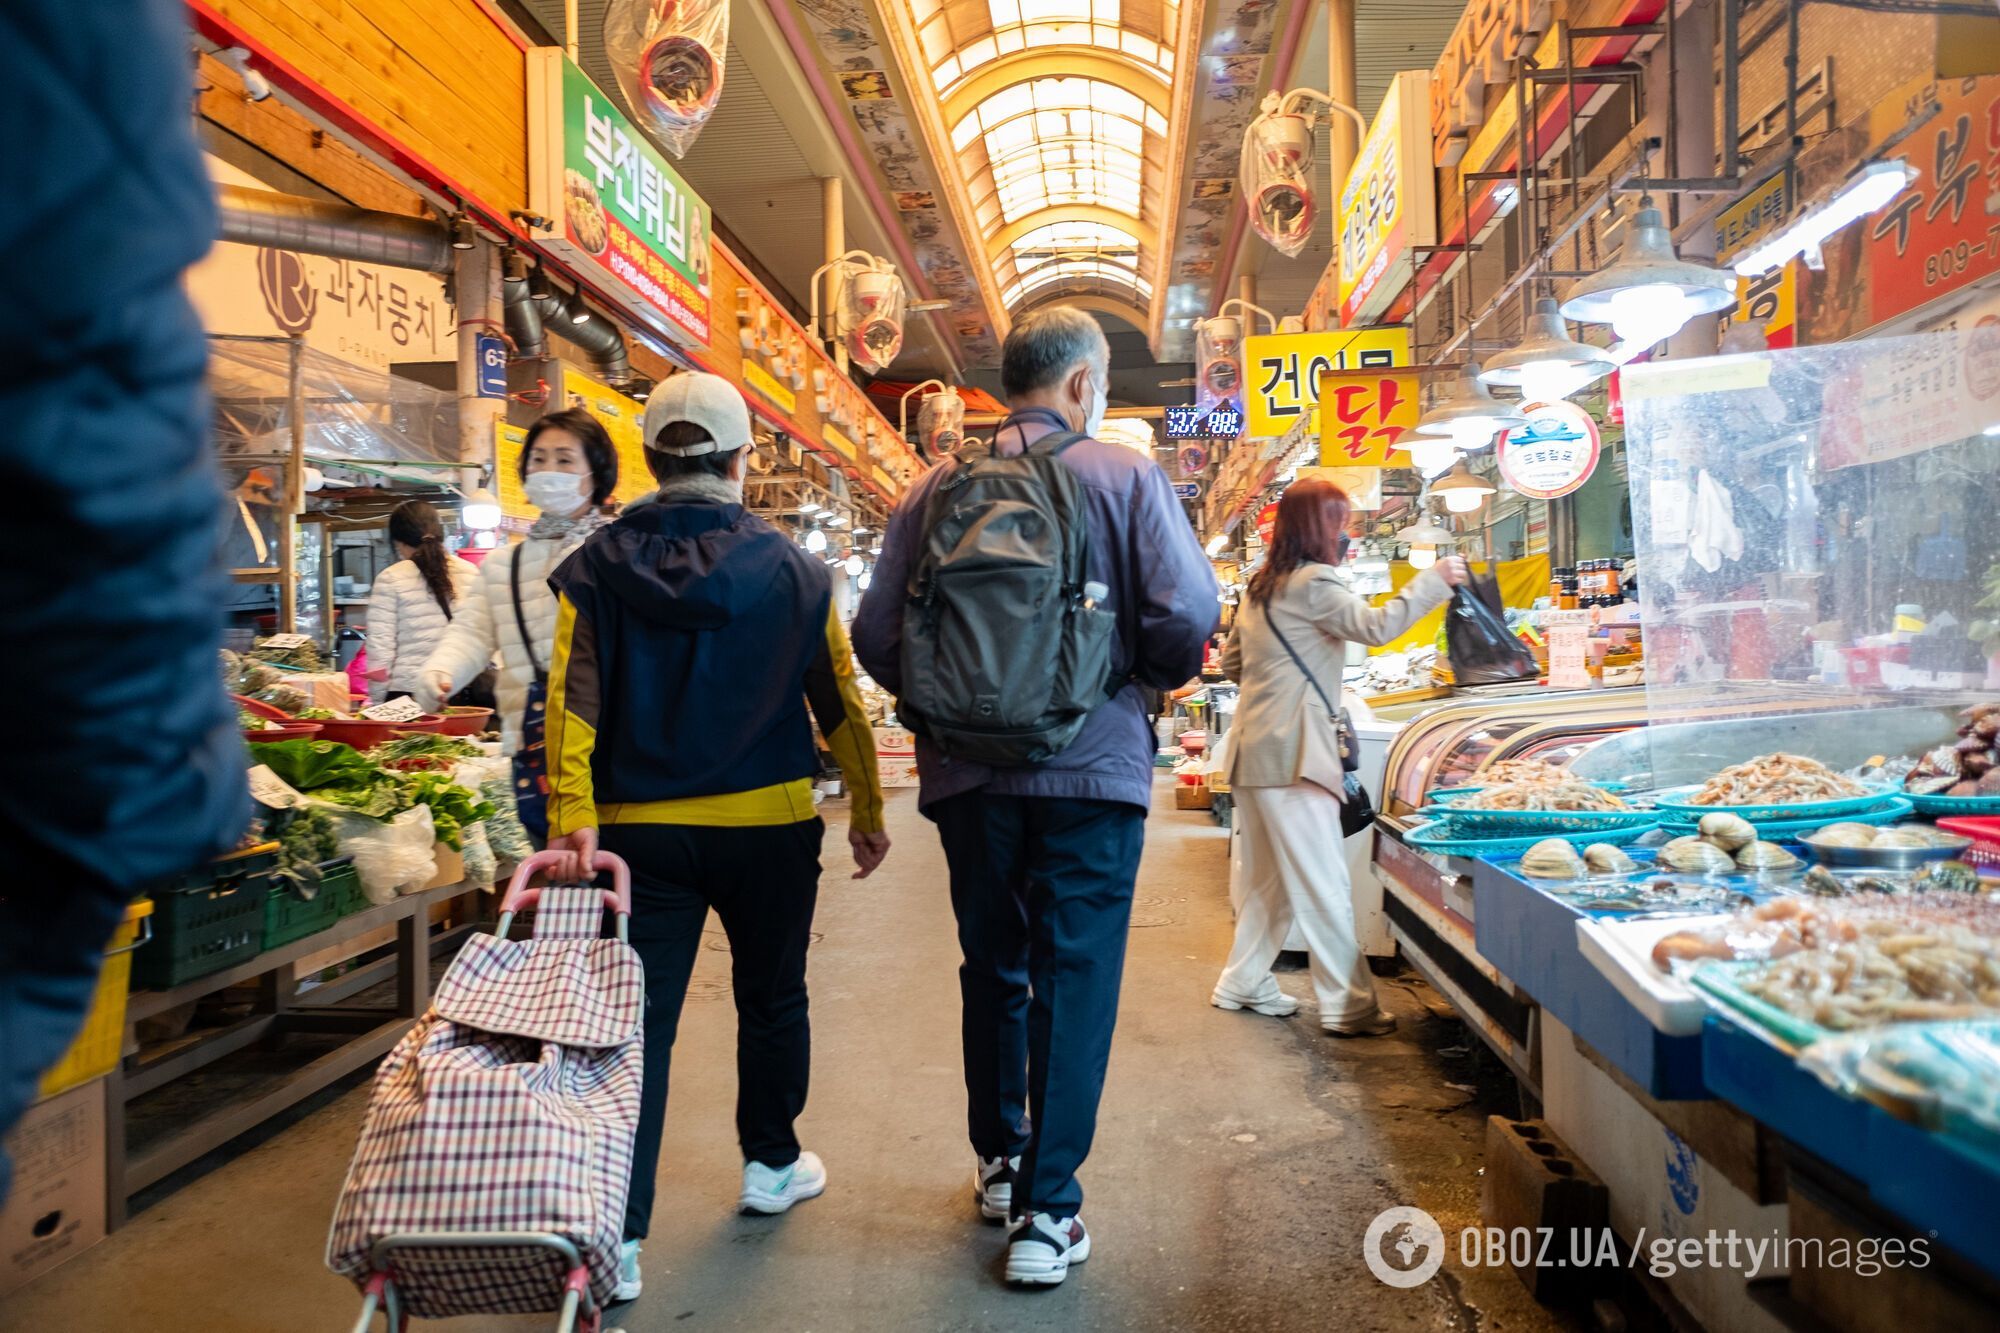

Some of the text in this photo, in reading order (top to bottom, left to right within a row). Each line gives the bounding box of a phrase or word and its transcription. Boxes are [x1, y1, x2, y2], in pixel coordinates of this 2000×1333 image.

[584, 95, 686, 263] 부전튀김
[325, 257, 438, 355] 과자뭉치
[1333, 379, 1411, 461] 닭
